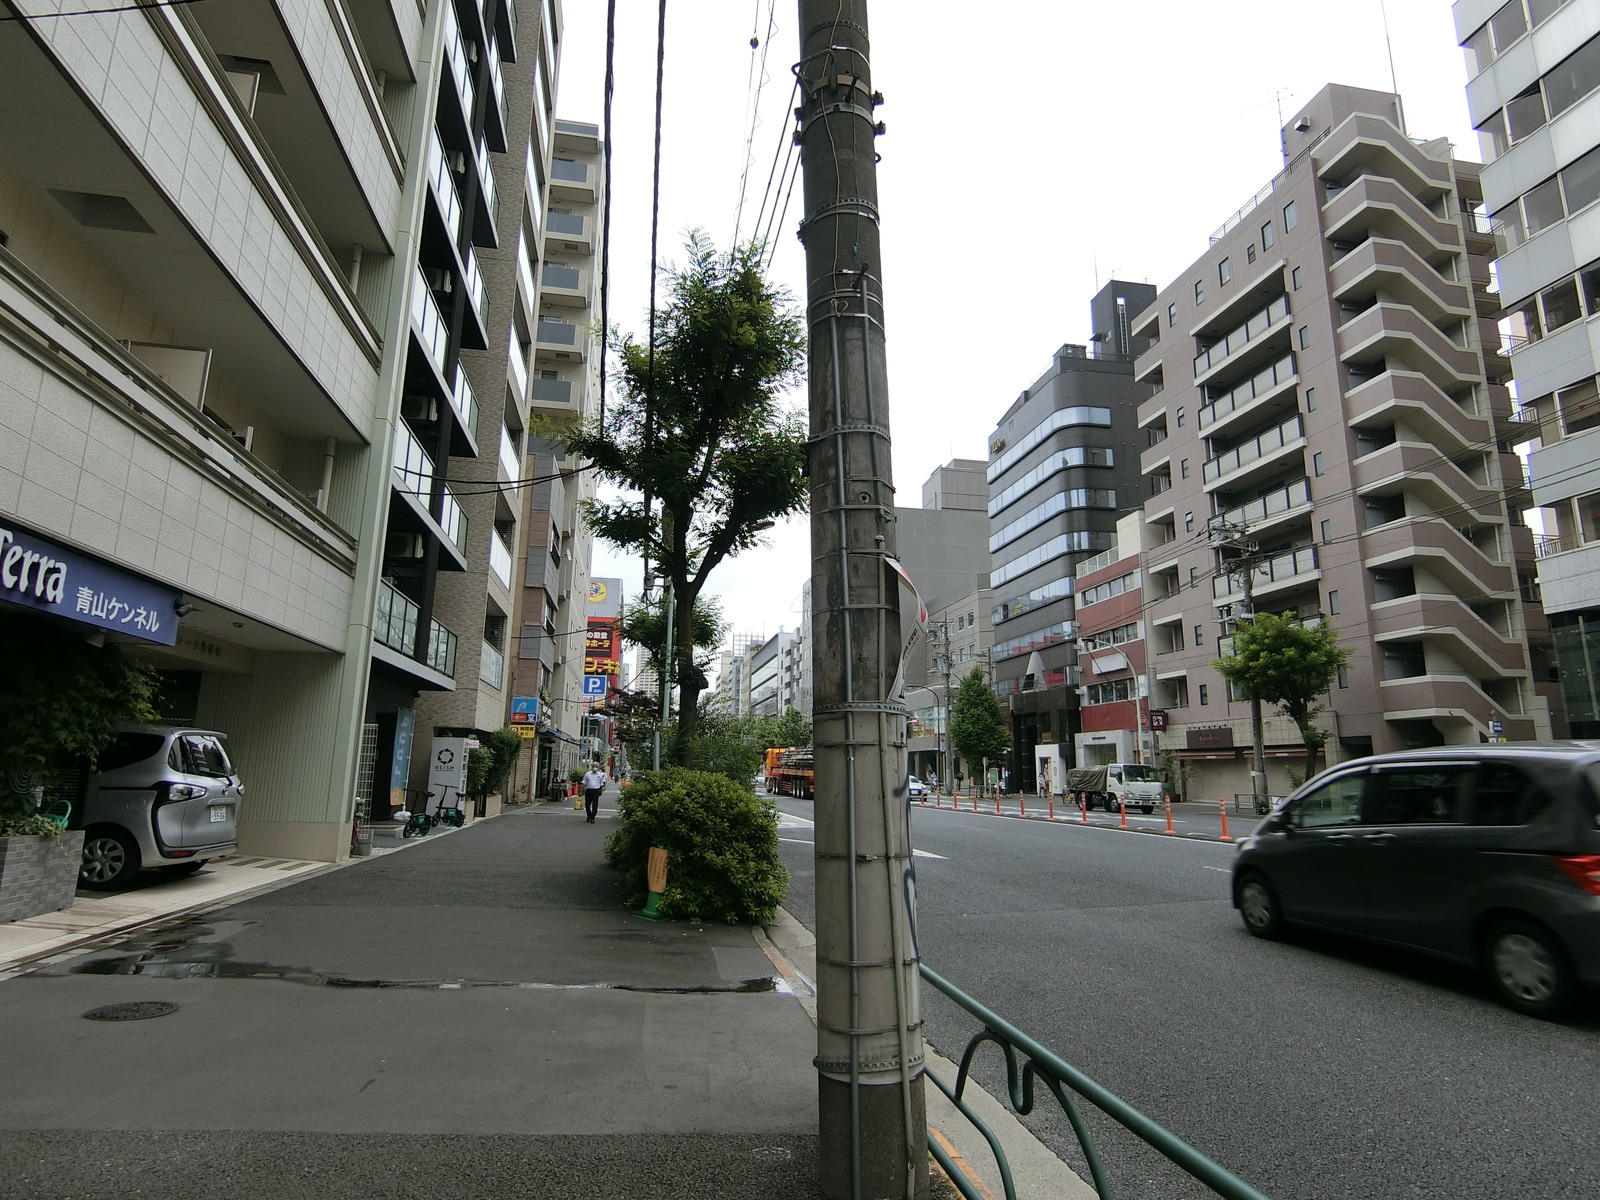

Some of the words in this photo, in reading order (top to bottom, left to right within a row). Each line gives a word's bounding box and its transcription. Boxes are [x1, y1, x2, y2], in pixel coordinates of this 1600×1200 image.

[76, 586, 160, 633] 青山ケンネル
[588, 677, 601, 693] P
